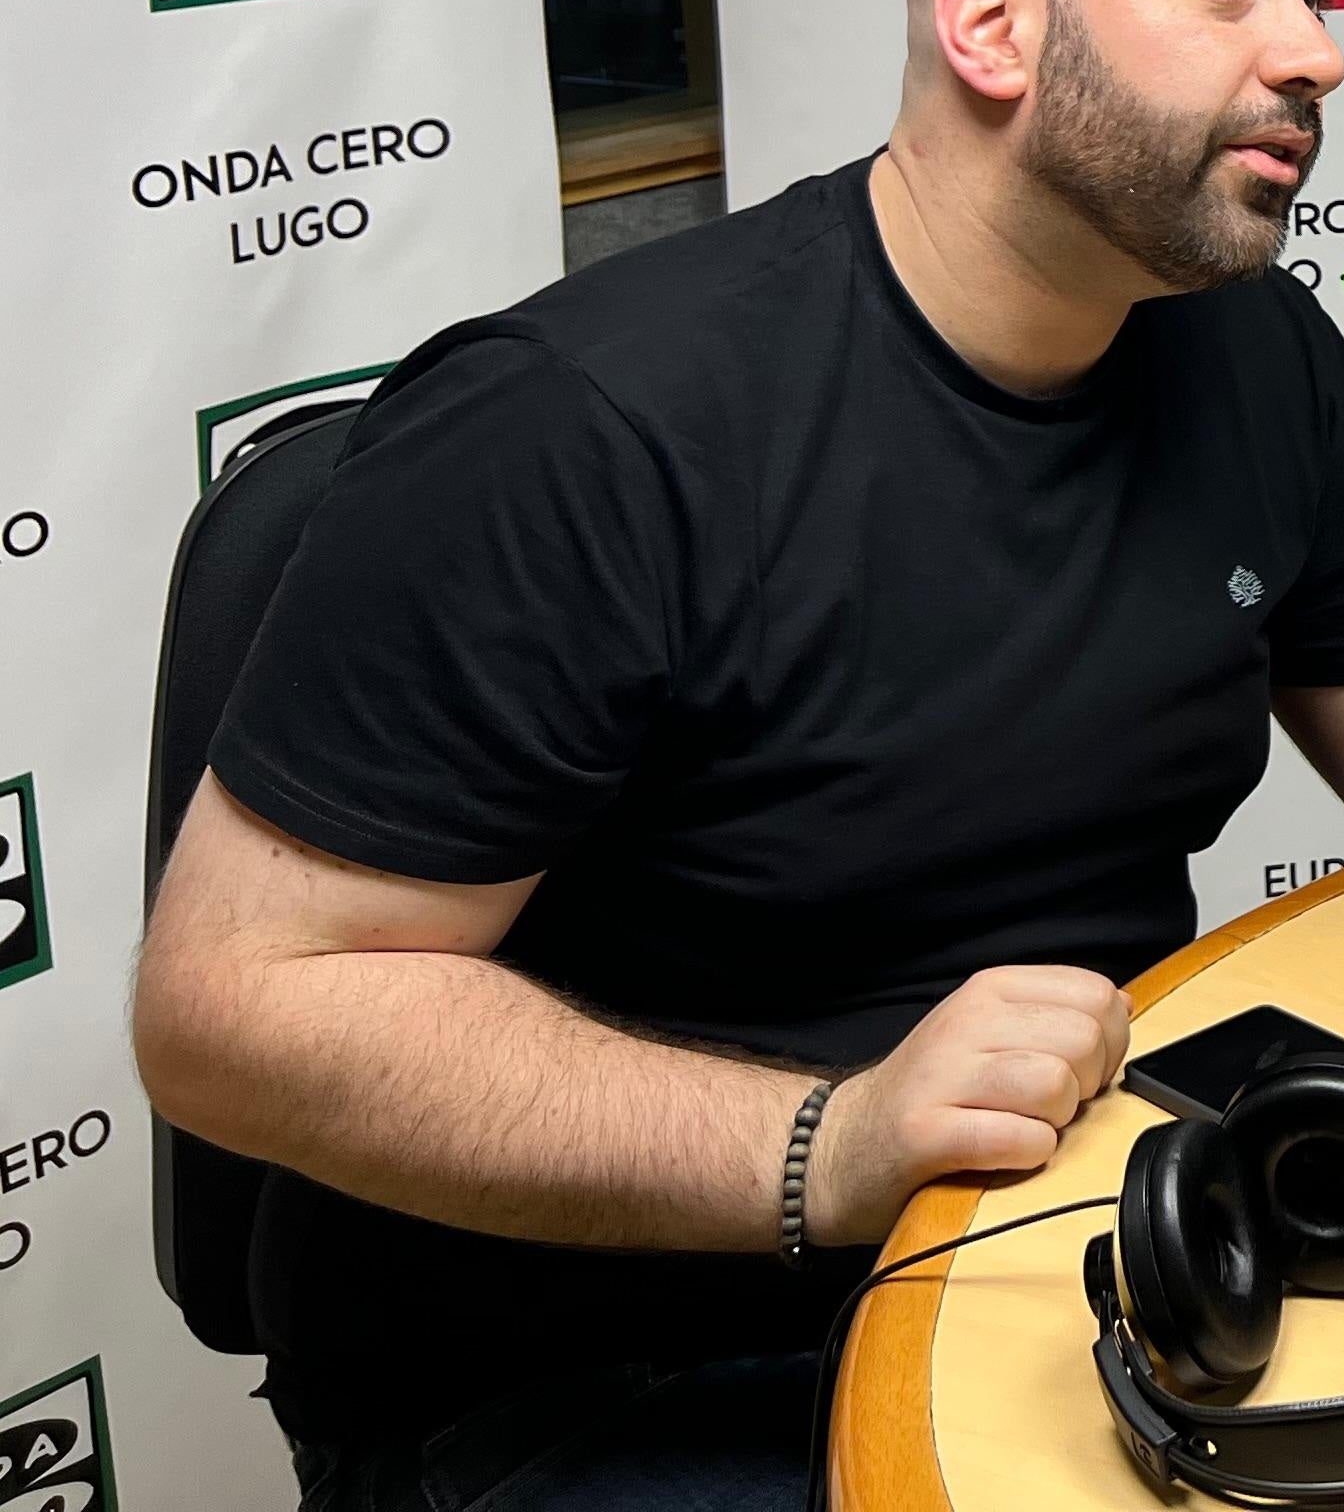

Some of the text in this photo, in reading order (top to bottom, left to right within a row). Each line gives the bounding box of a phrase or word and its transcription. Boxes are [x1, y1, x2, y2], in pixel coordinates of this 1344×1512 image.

[133, 120, 451, 209] ONDA CERO
[231, 199, 370, 265] LUGO
